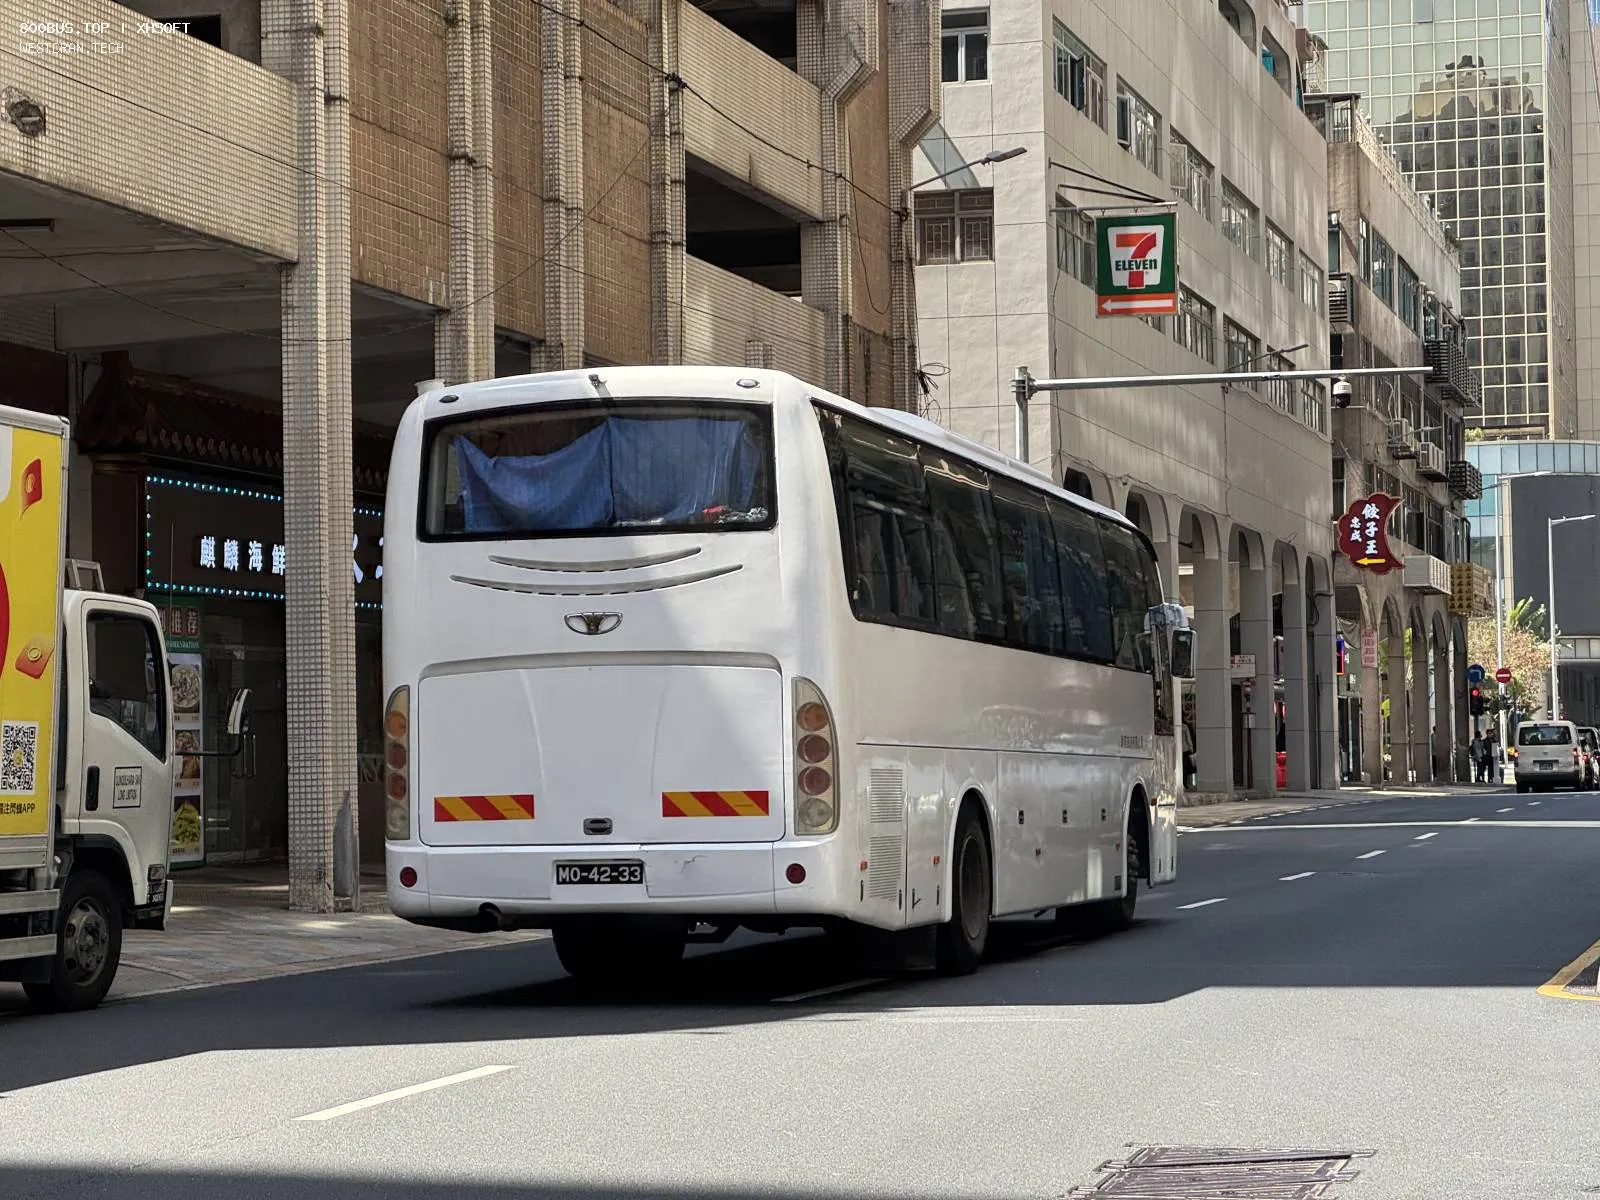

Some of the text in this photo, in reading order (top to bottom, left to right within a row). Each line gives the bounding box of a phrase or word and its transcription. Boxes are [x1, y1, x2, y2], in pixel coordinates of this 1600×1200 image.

[1115, 232, 1157, 288] 7
[1362, 503, 1380, 555] 餃子王
[558, 866, 642, 883] MO-42-33
